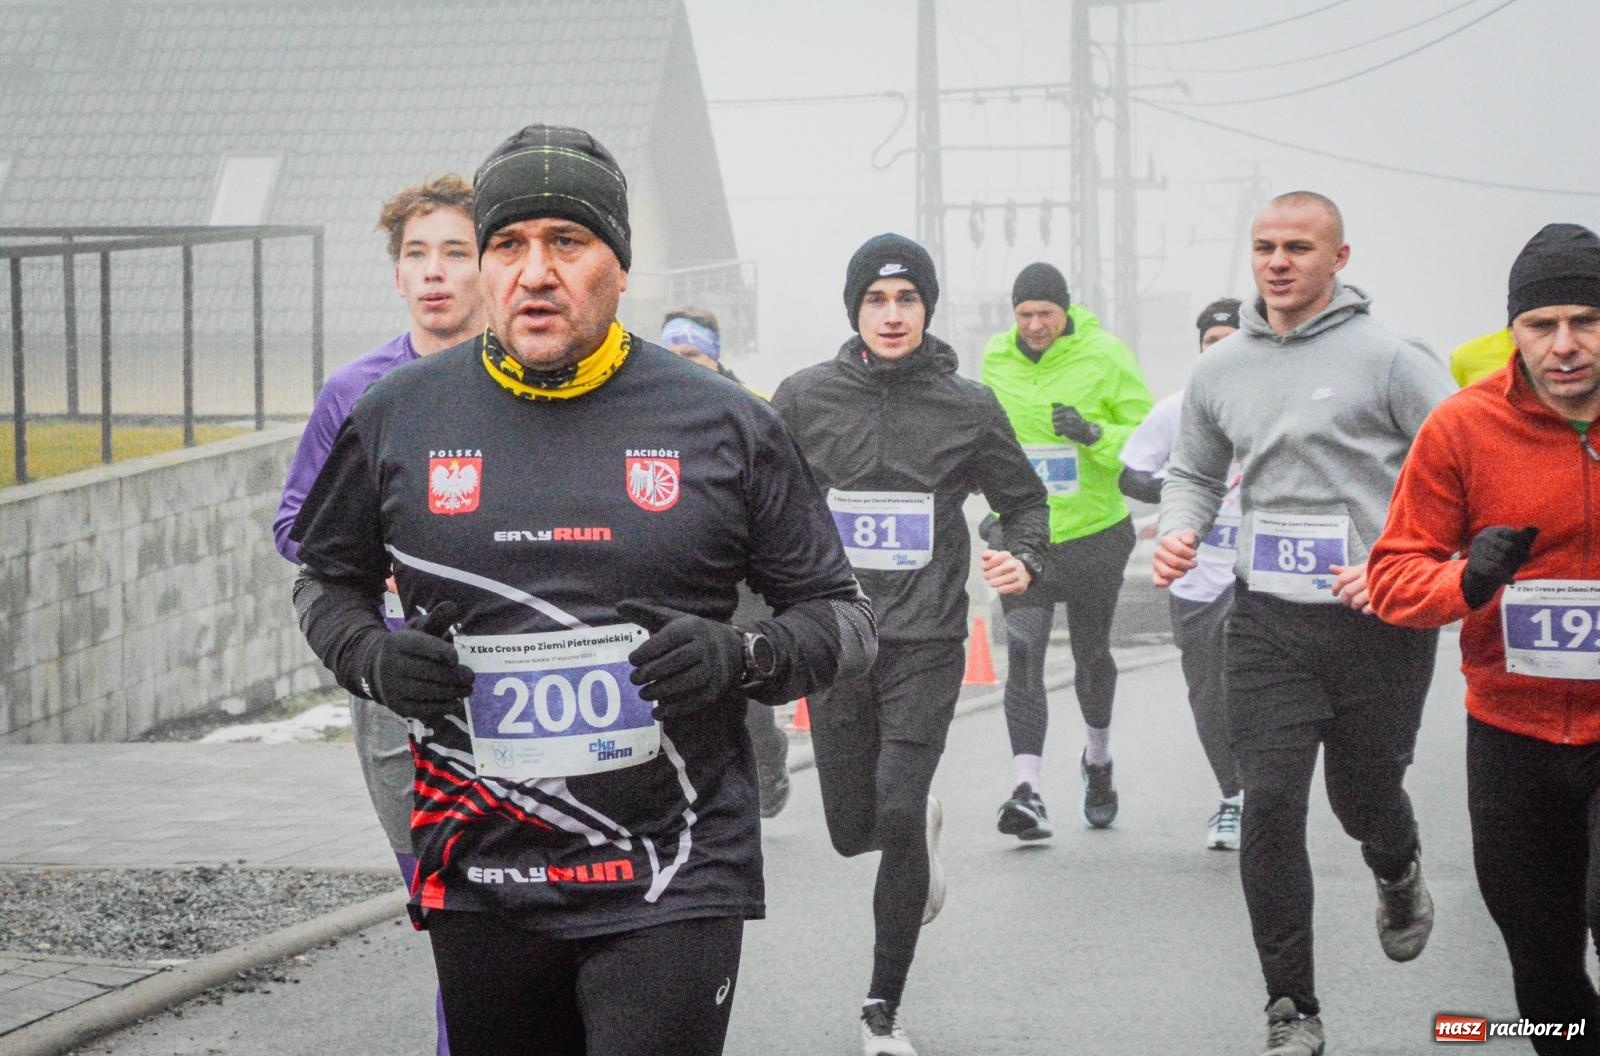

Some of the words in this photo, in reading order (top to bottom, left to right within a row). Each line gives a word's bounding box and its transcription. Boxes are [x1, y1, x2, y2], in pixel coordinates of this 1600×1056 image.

[429, 449, 483, 458] POLSKA
[625, 448, 680, 458] RACIBÓRZ
[854, 515, 901, 548] 81
[1218, 526, 1239, 548] 1
[1278, 538, 1317, 573] 85
[470, 645, 477, 654] X
[477, 645, 494, 653] Eko
[495, 645, 522, 653] Cross
[524, 645, 536, 654] po
[537, 640, 566, 651] Ziemi
[567, 632, 633, 648] Pietrowickiej
[493, 669, 621, 734] 200
